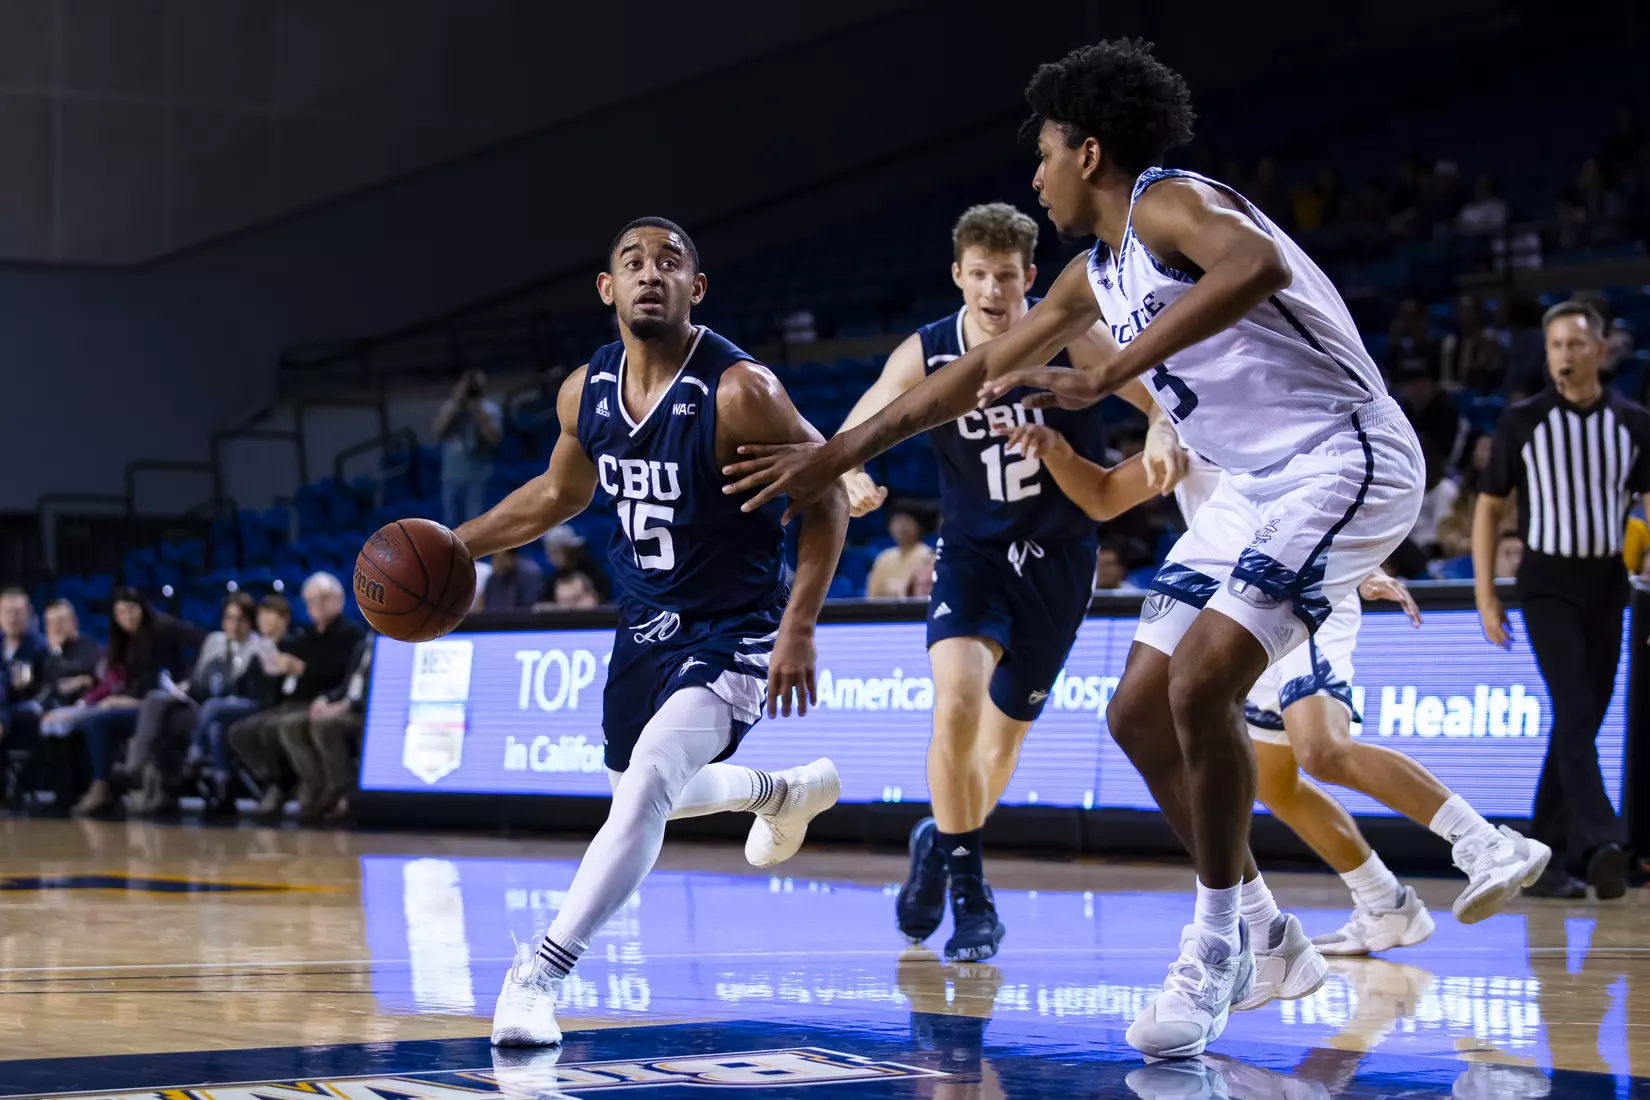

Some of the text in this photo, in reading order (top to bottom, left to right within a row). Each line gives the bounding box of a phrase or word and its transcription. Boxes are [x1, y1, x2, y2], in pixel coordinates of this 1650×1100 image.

[672, 403, 697, 416] WAC
[598, 453, 682, 502] CBU
[980, 443, 1042, 502] 12
[515, 649, 597, 712] TOP
[815, 667, 935, 711] America
[1379, 684, 1542, 738] Health
